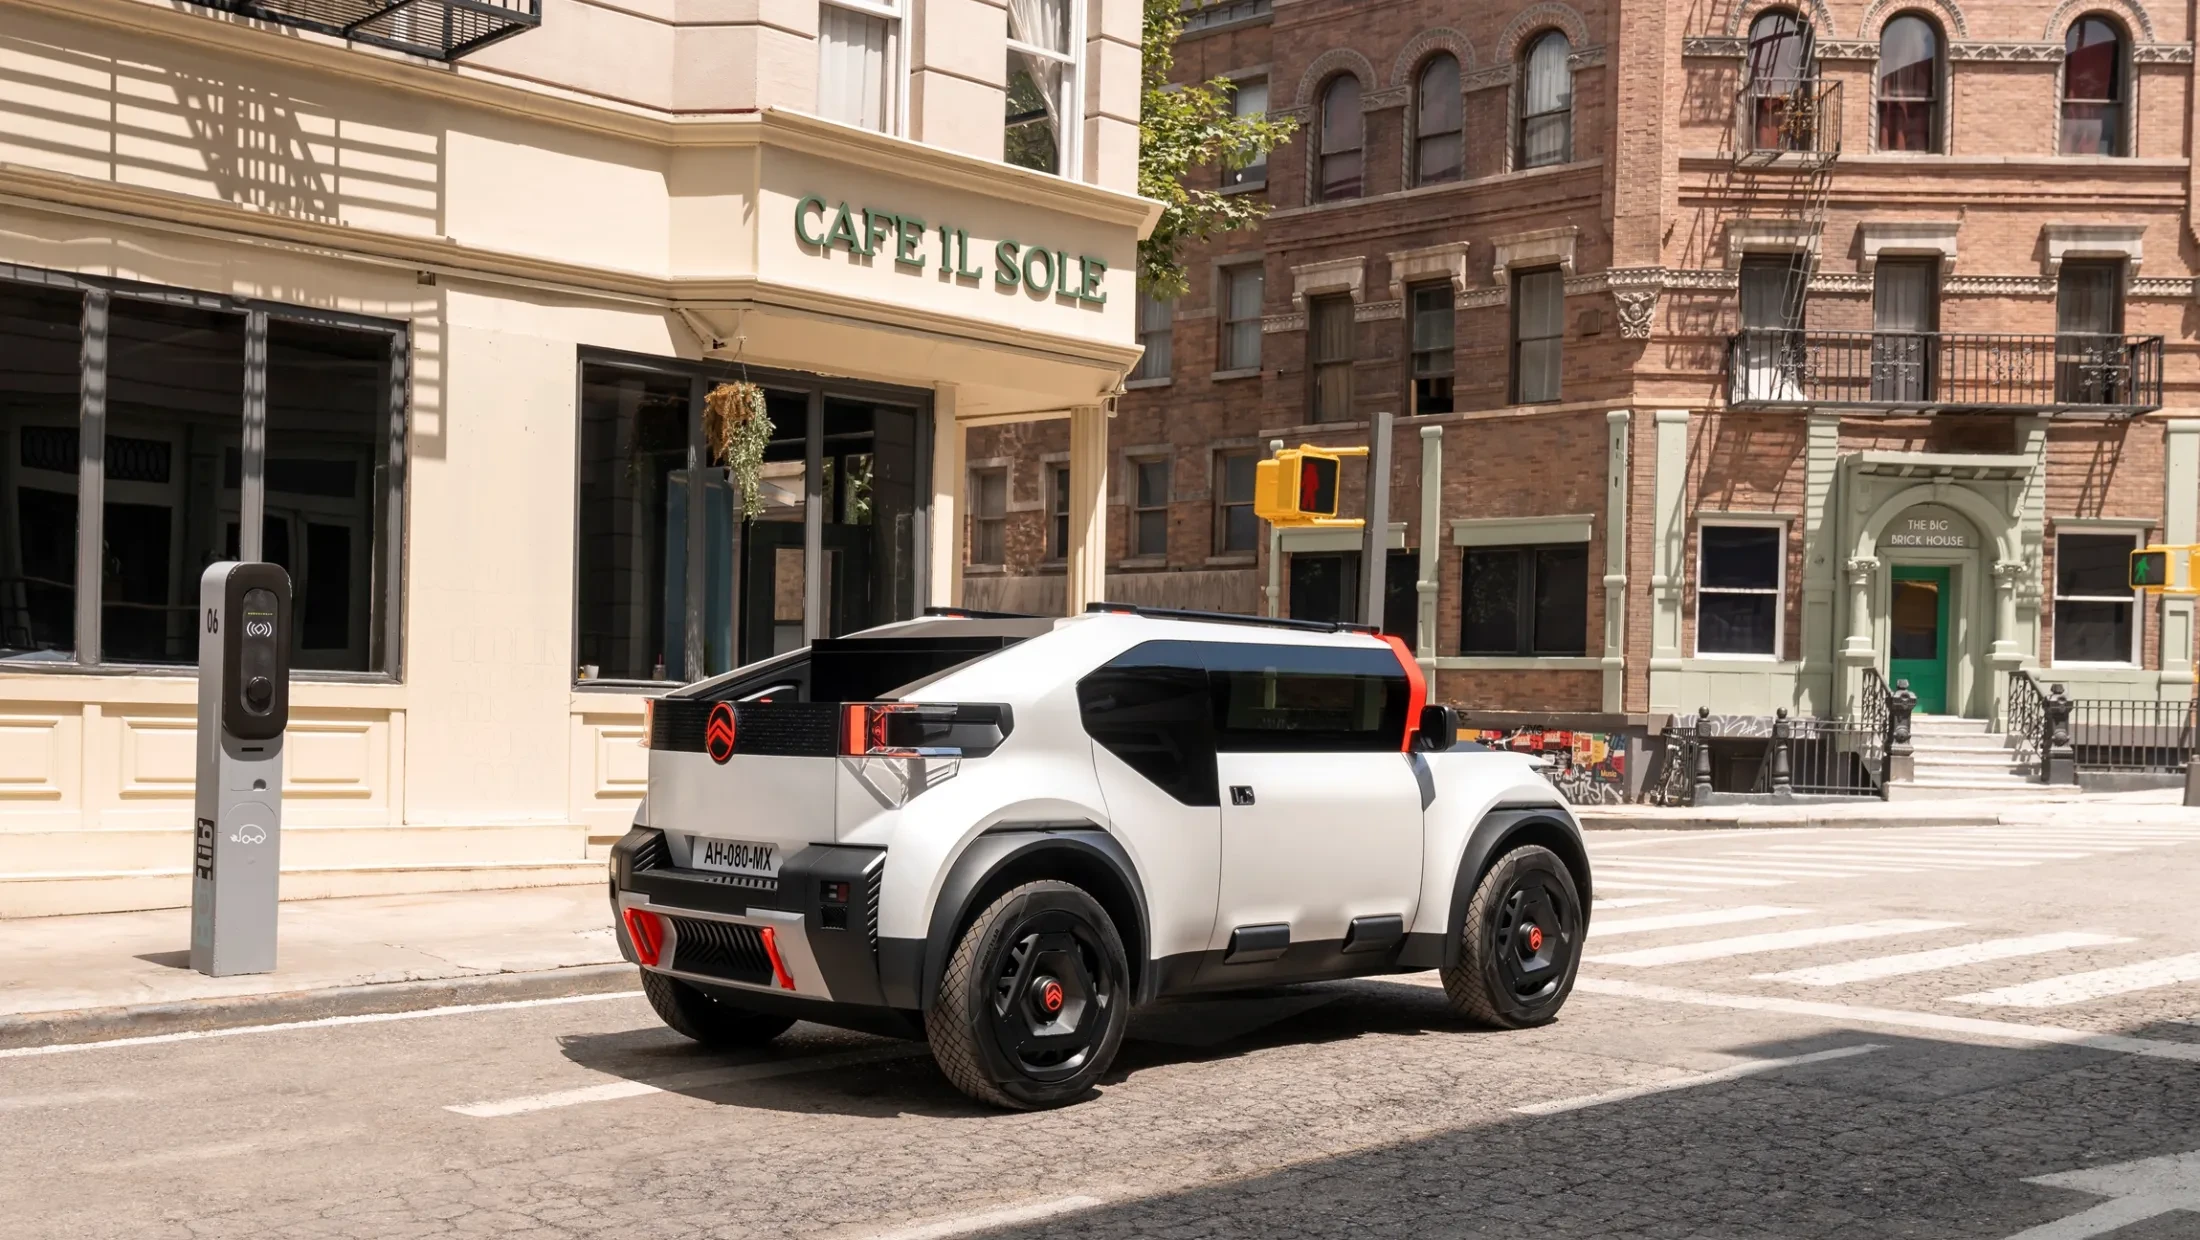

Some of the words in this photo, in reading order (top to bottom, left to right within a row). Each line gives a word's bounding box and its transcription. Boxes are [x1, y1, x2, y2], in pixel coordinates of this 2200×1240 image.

[794, 194, 926, 268] CAFE
[939, 225, 983, 279] IL
[995, 238, 1108, 304] SOLE
[1908, 519, 1927, 530] THE
[1929, 519, 1949, 531] BIG
[1891, 534, 1922, 545] BRICK
[1926, 535, 1964, 547] HOUSE
[206, 607, 219, 634] 06
[1600, 769, 1618, 778] Music
[703, 841, 773, 872] AH-080-MX
